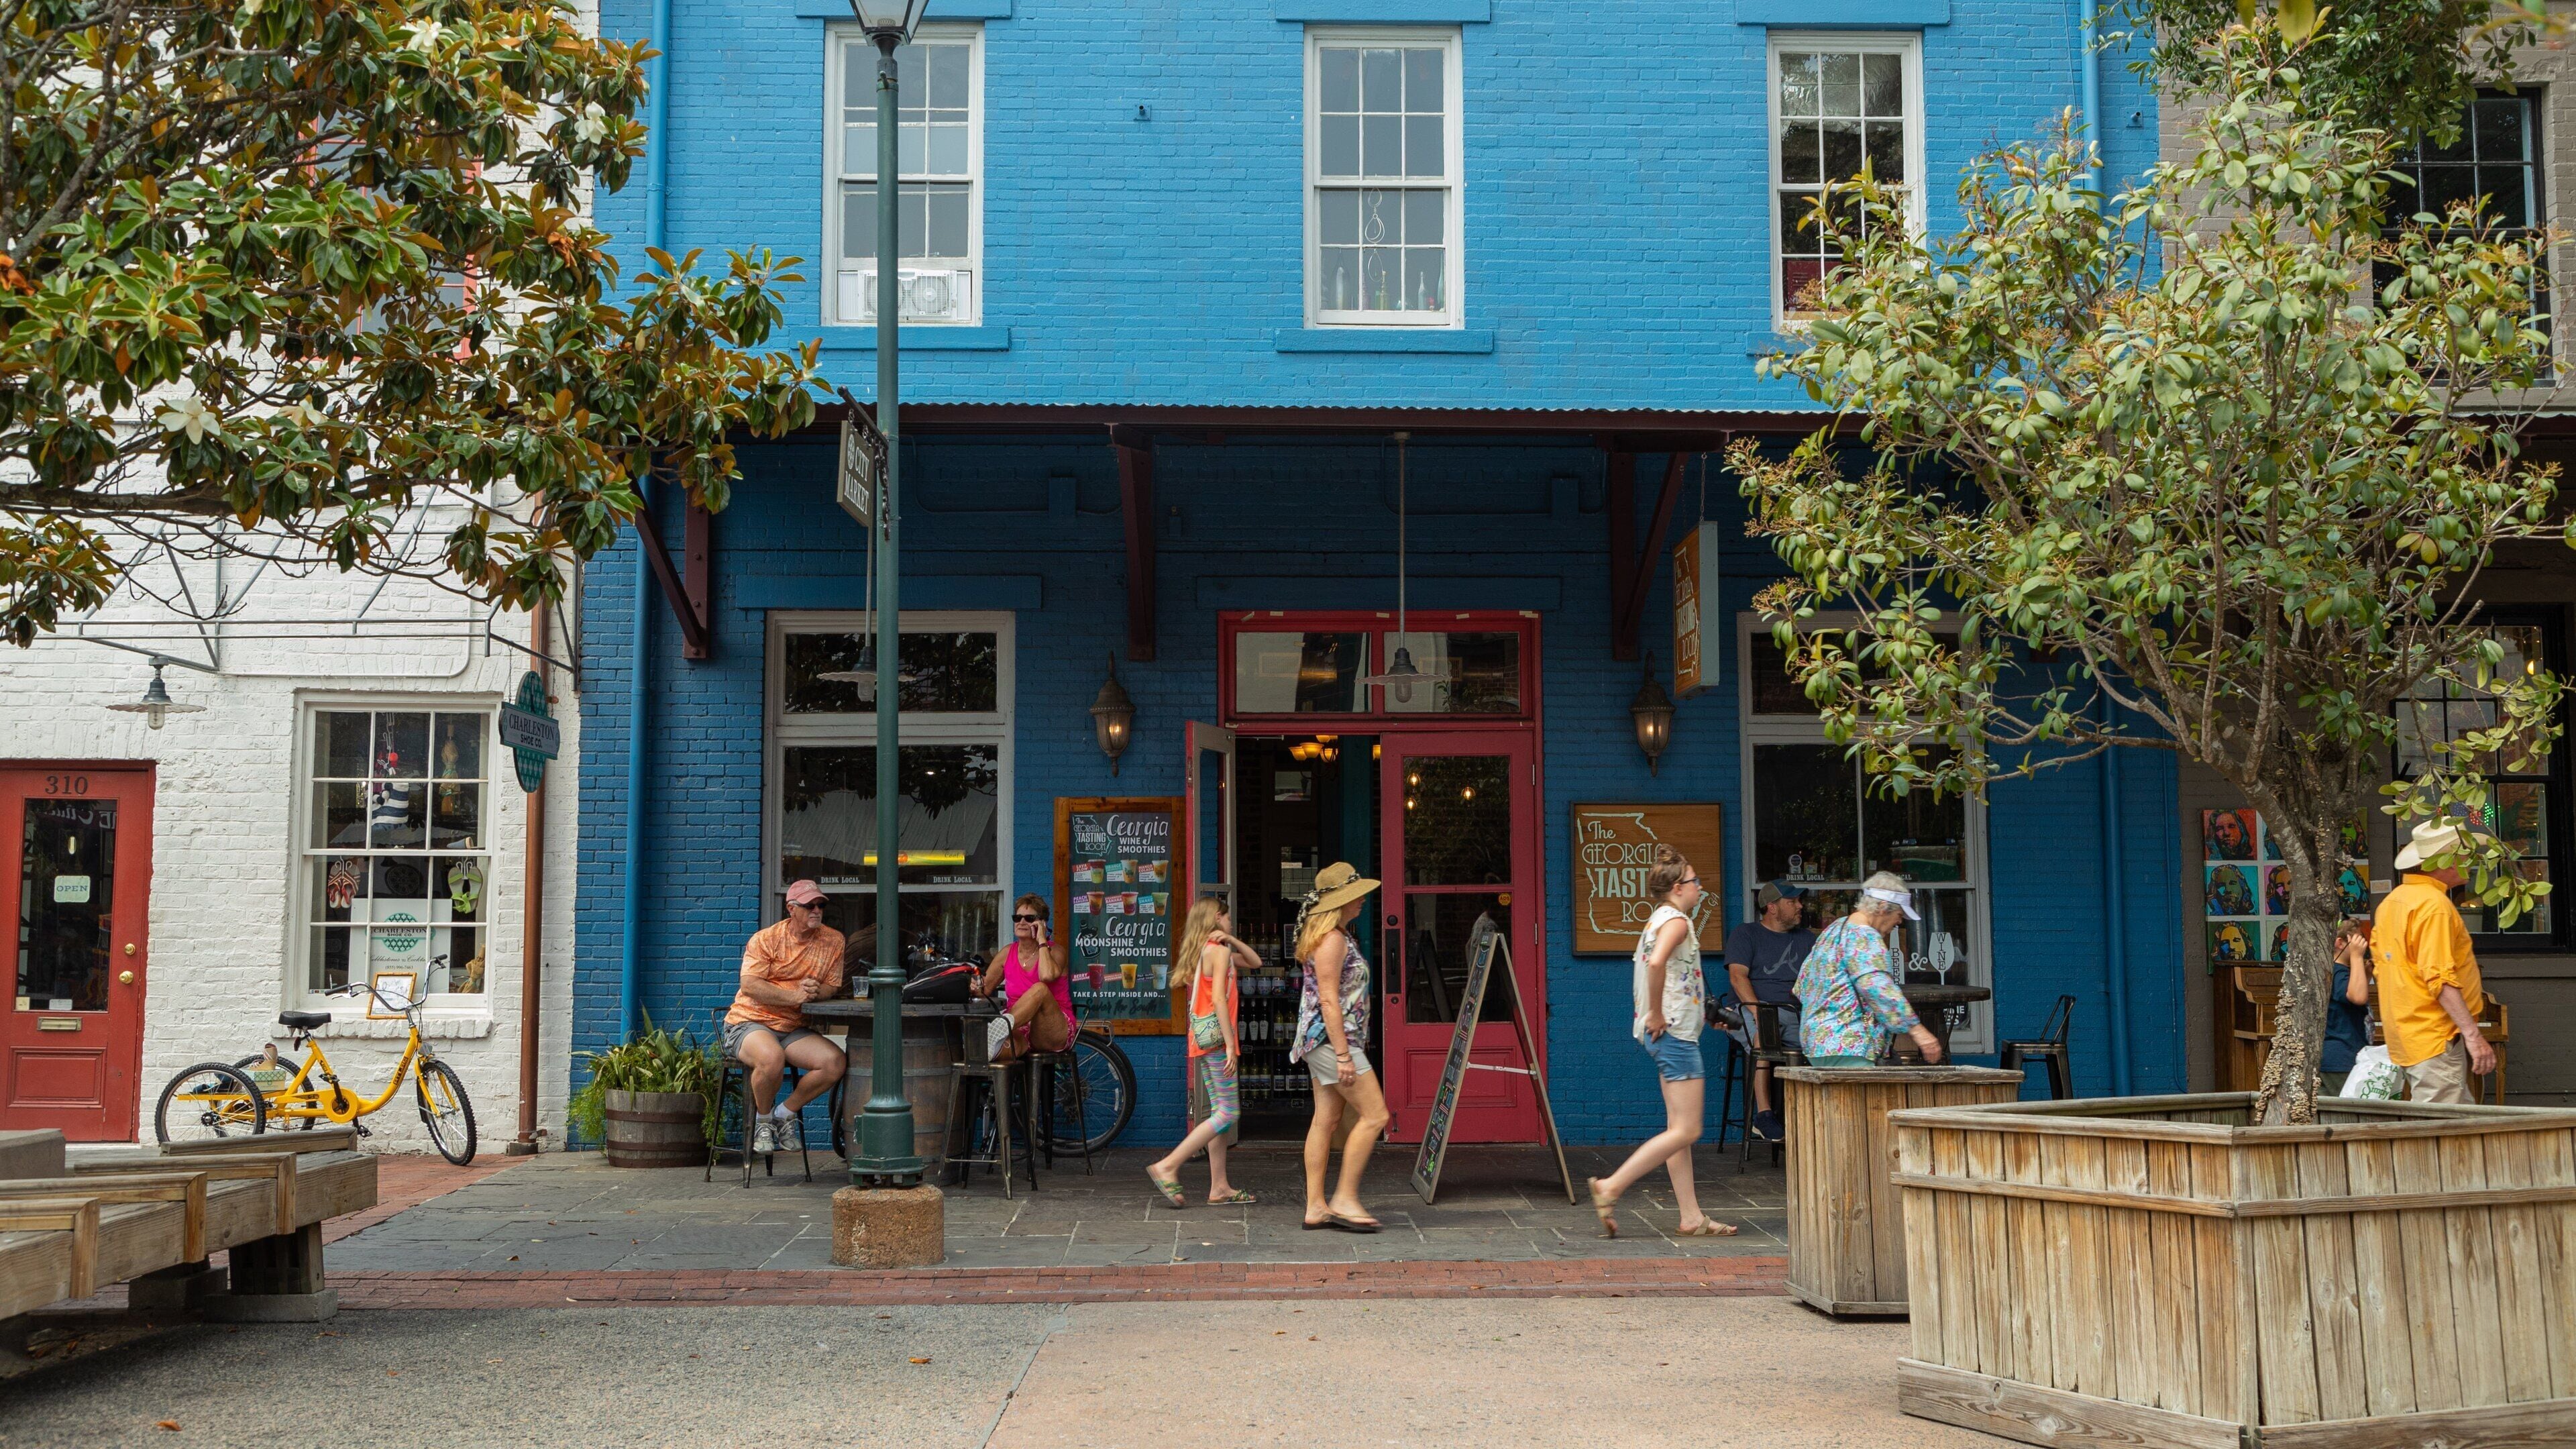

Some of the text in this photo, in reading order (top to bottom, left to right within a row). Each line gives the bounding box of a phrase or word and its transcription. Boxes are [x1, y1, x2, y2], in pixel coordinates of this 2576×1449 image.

[855, 446, 869, 482] CITY
[844, 471, 869, 515] MARKET
[509, 714, 555, 741] CHARLESTON
[521, 734, 533, 745] SHOE
[45, 775, 89, 794] 310
[1078, 833, 1106, 843] TASTING
[1107, 814, 1168, 845] Georgia
[1588, 821, 1616, 840] The
[1595, 868, 1654, 898] TAST
[1708, 892, 1720, 907] GA
[1621, 901, 1662, 922] RO
[1106, 916, 1165, 945] Georgia
[1075, 938, 1134, 947] MOONSHINE
[1110, 948, 1167, 957] SMOOTHIES
[1936, 932, 1947, 970] WINE
